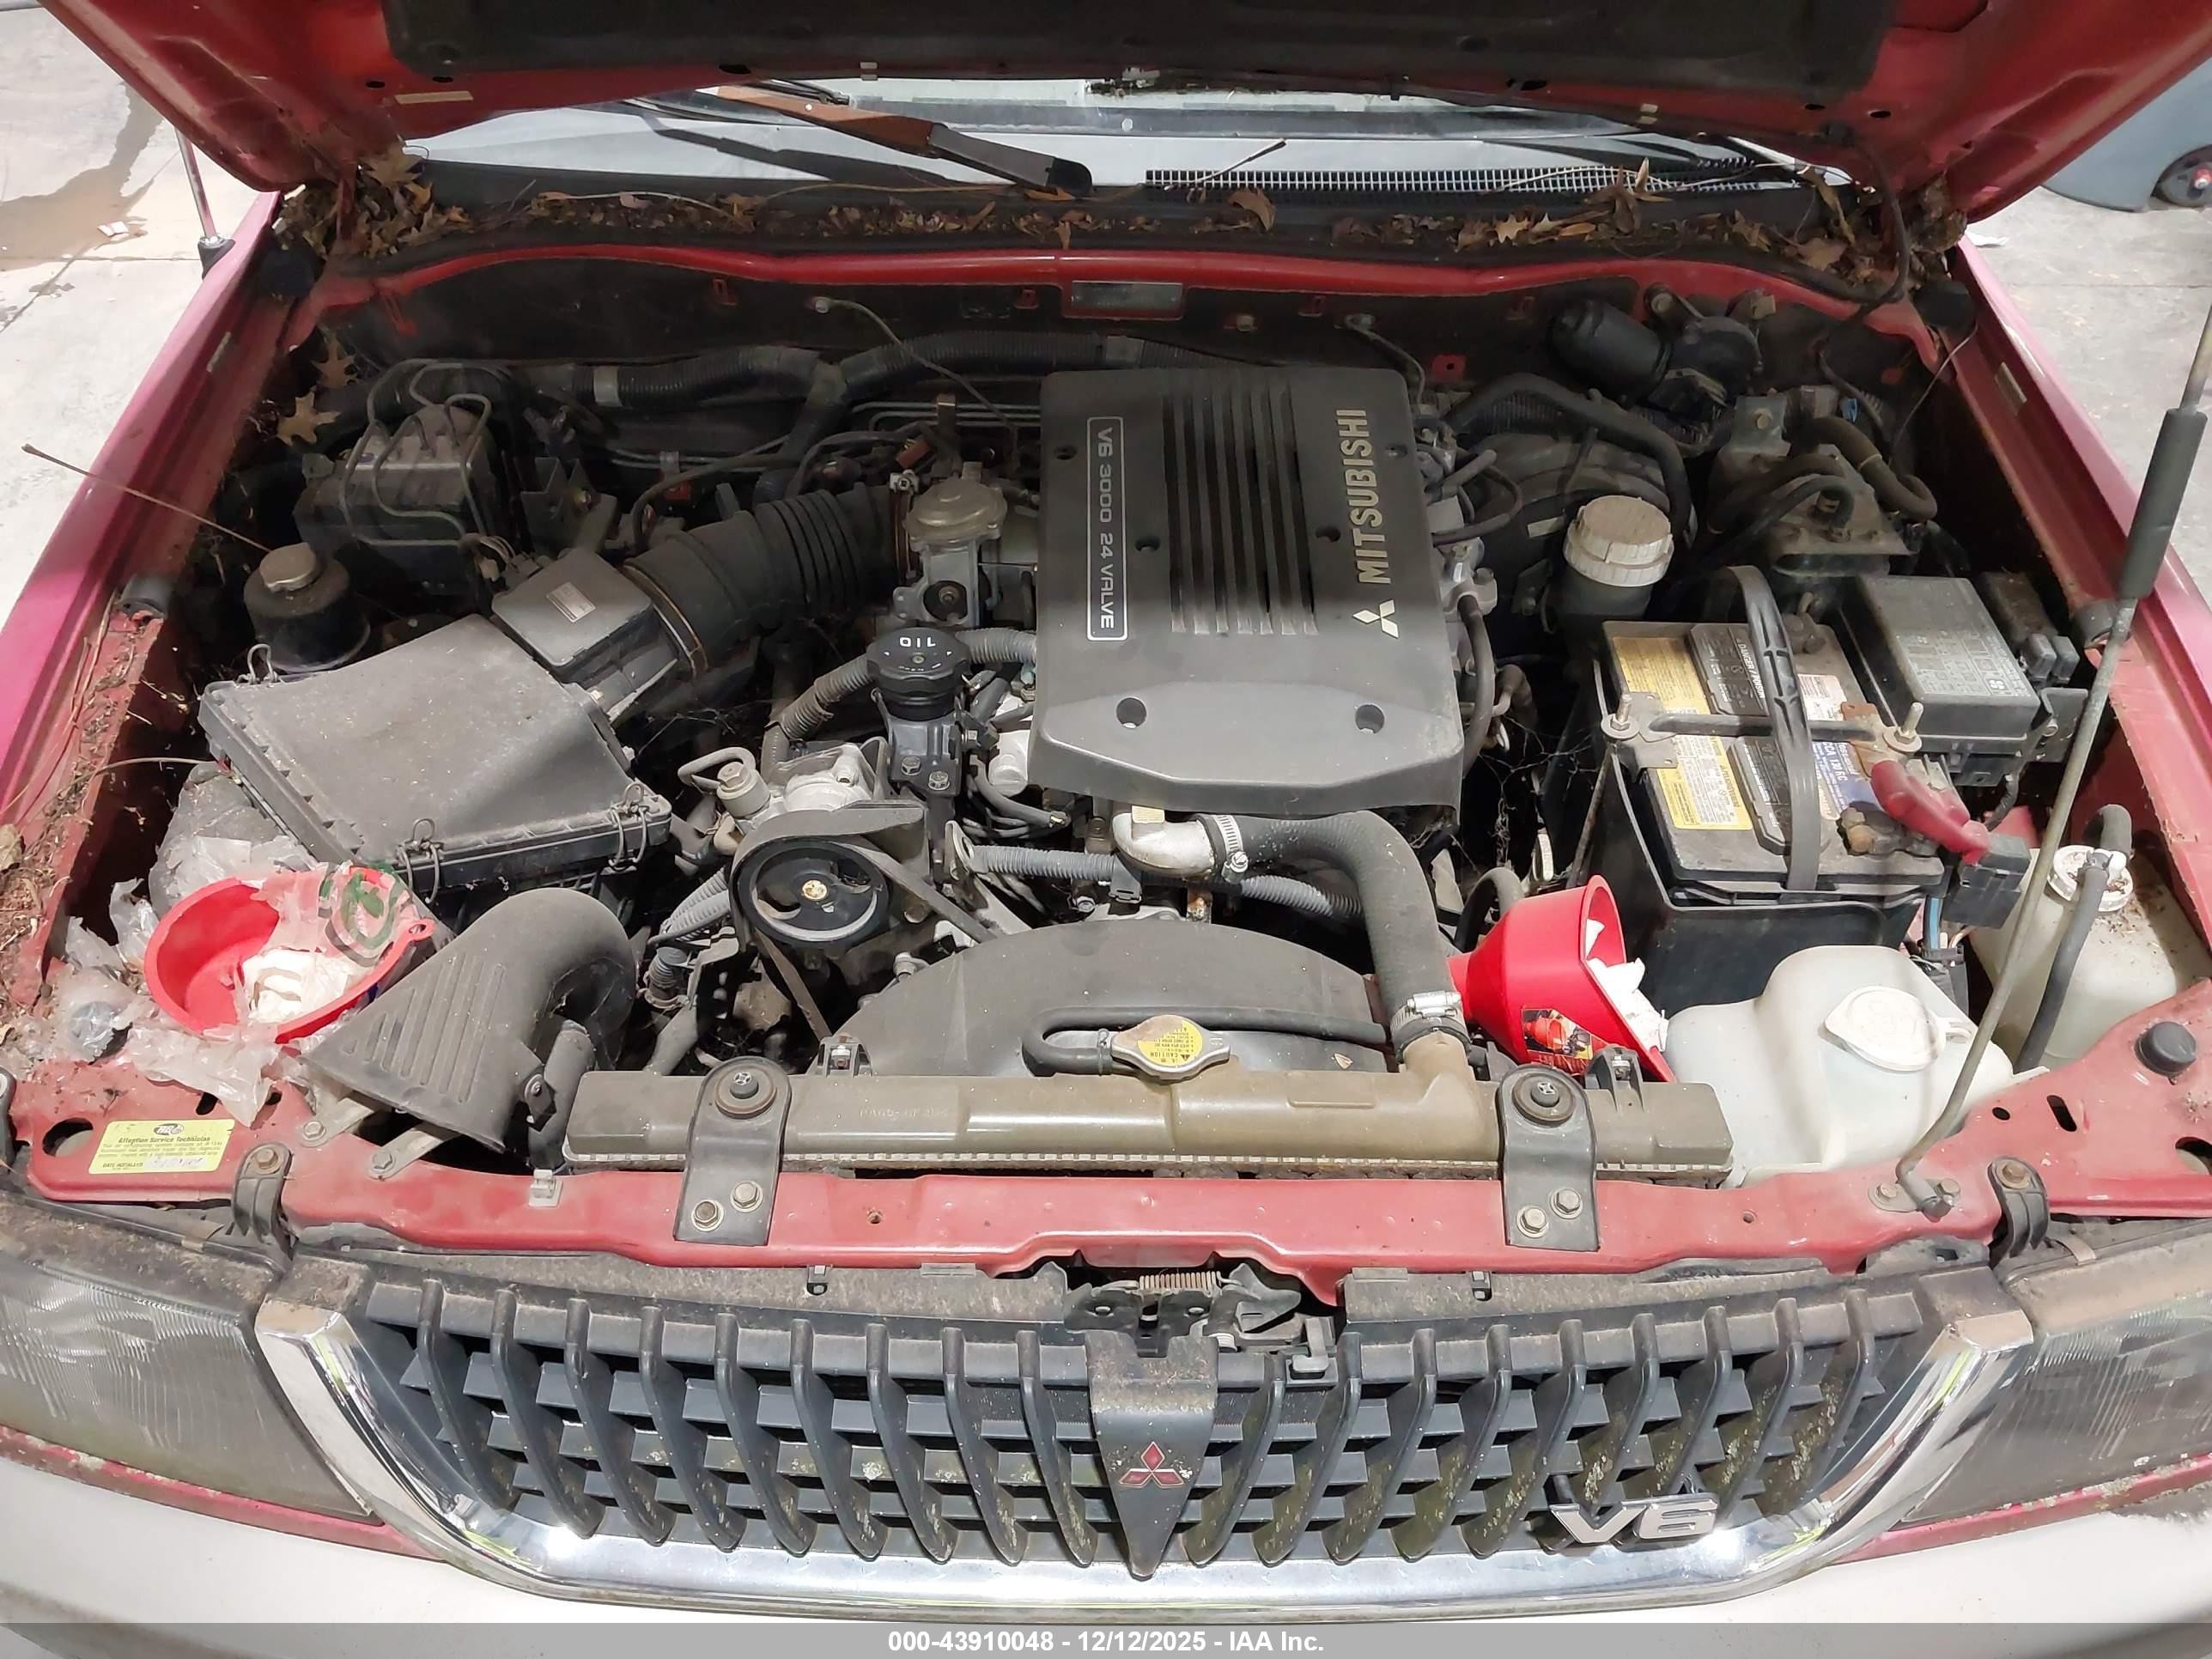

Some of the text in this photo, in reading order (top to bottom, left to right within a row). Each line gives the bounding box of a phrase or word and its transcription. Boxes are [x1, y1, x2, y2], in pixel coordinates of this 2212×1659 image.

[1095, 427, 1115, 630] V6 3000 24 VALVE
[1336, 409, 1391, 585] MITSUBISHI
[899, 636, 936, 647] OIL
[1551, 1494, 1717, 1543] V6
